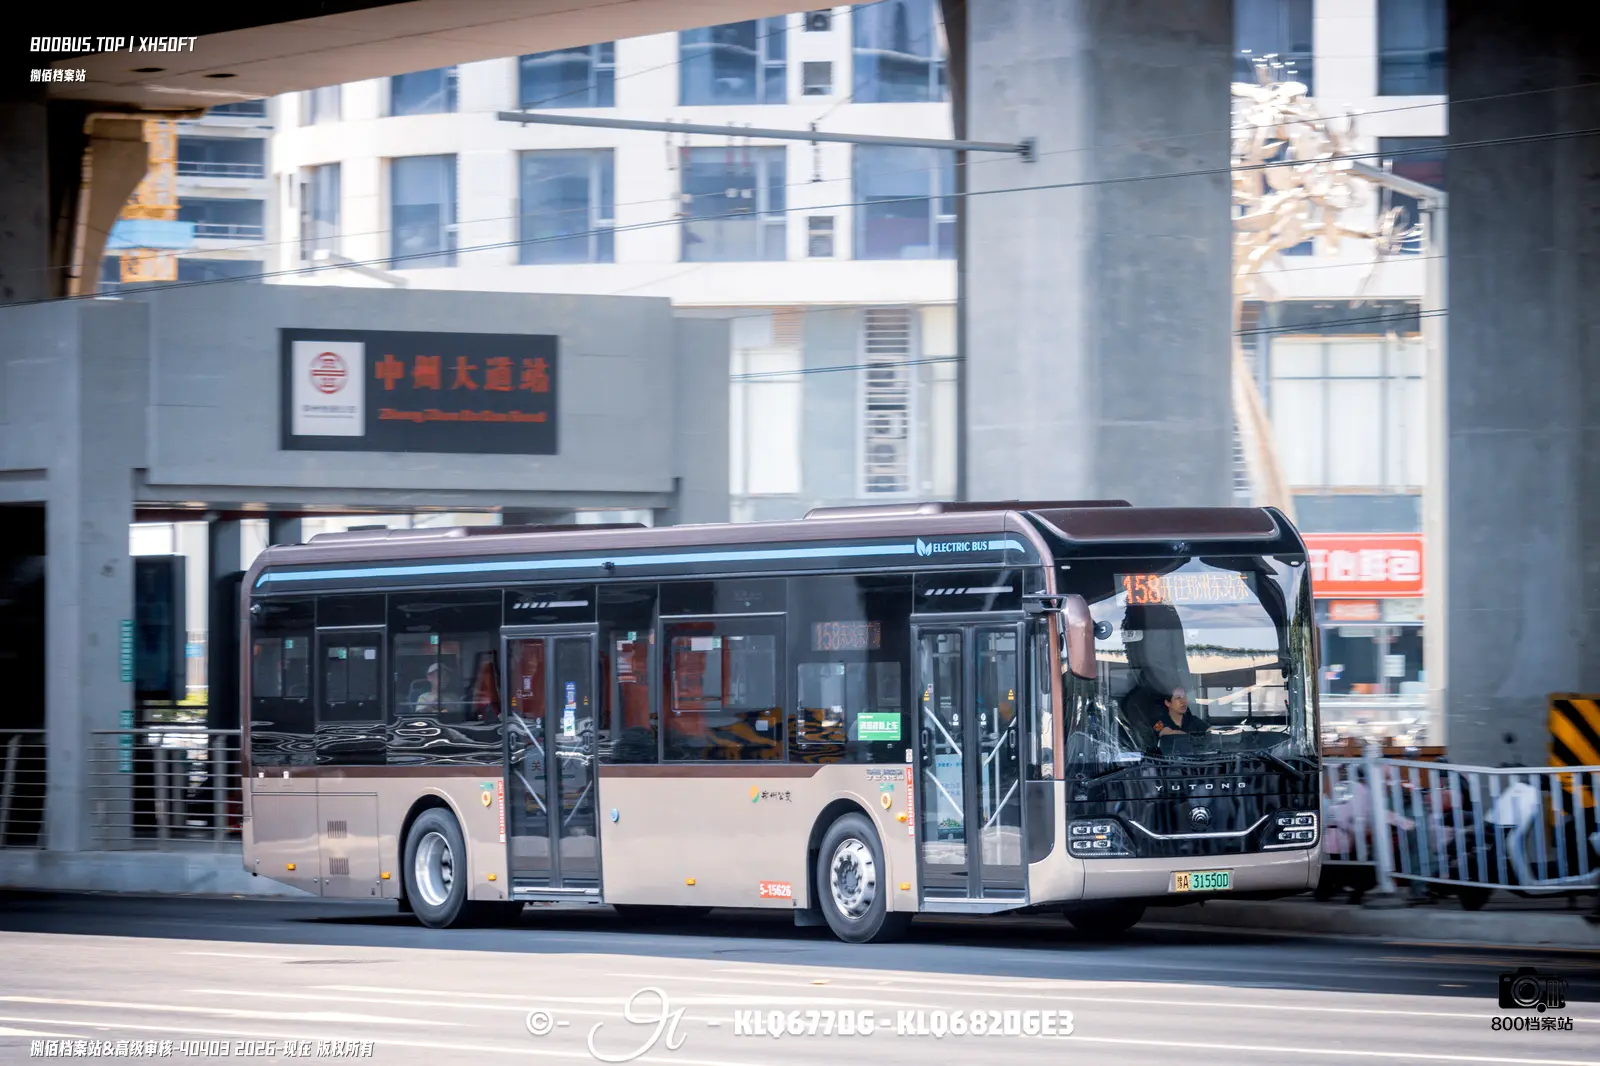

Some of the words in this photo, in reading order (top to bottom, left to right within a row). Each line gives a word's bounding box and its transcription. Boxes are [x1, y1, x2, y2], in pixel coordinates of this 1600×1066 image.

[374, 353, 550, 393] 中州大道站
[933, 542, 971, 553] ELECTRIC
[971, 540, 988, 551] BUS
[1123, 574, 1162, 605] 158
[1155, 781, 1247, 792] YUTONG
[759, 883, 792, 897] 5-15626
